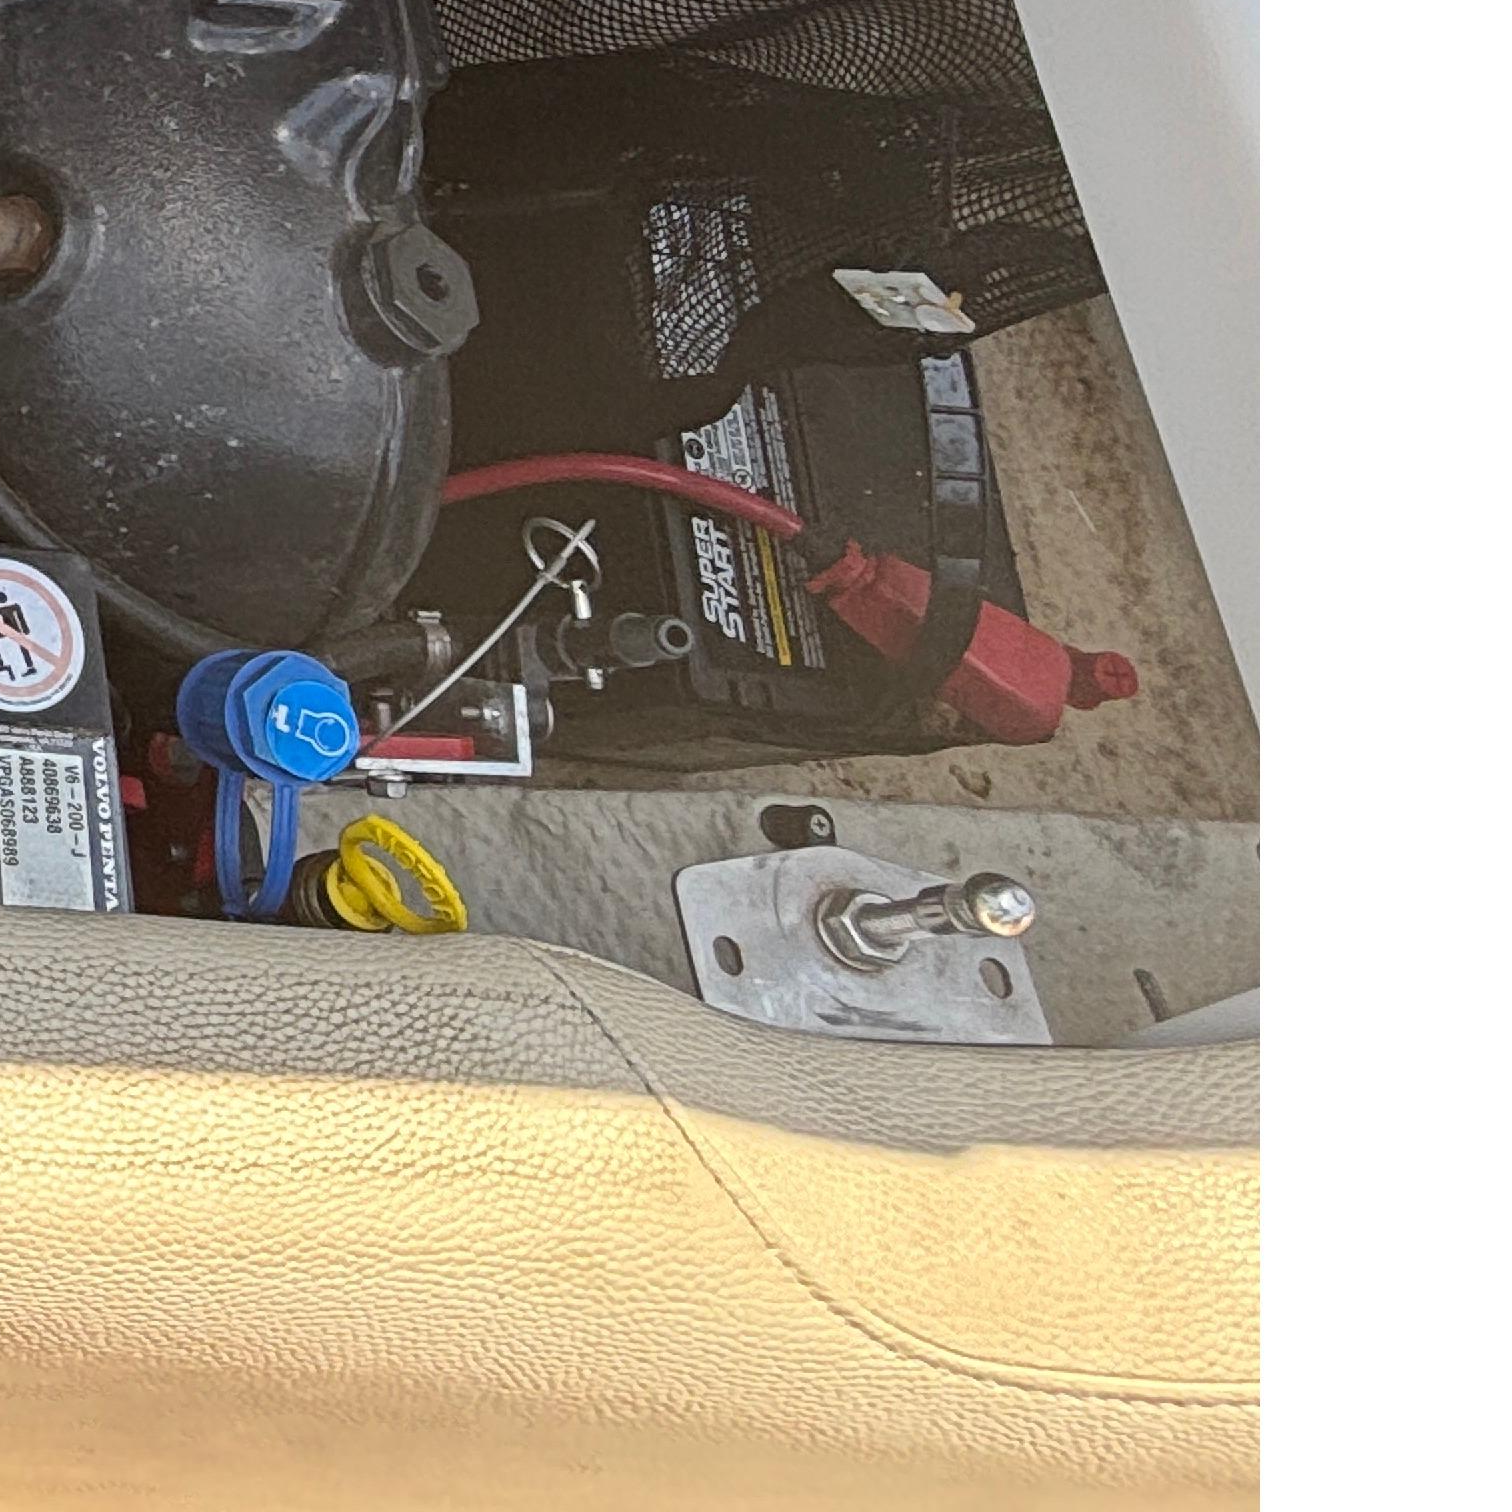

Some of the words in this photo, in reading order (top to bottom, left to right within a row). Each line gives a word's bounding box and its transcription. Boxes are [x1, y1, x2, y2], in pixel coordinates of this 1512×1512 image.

[691, 516, 719, 625] SUPER
[707, 517, 746, 643] START
[42, 758, 63, 834] 40869638
[92, 738, 112, 820] VOLVO
[99, 823, 120, 912] PENTA
